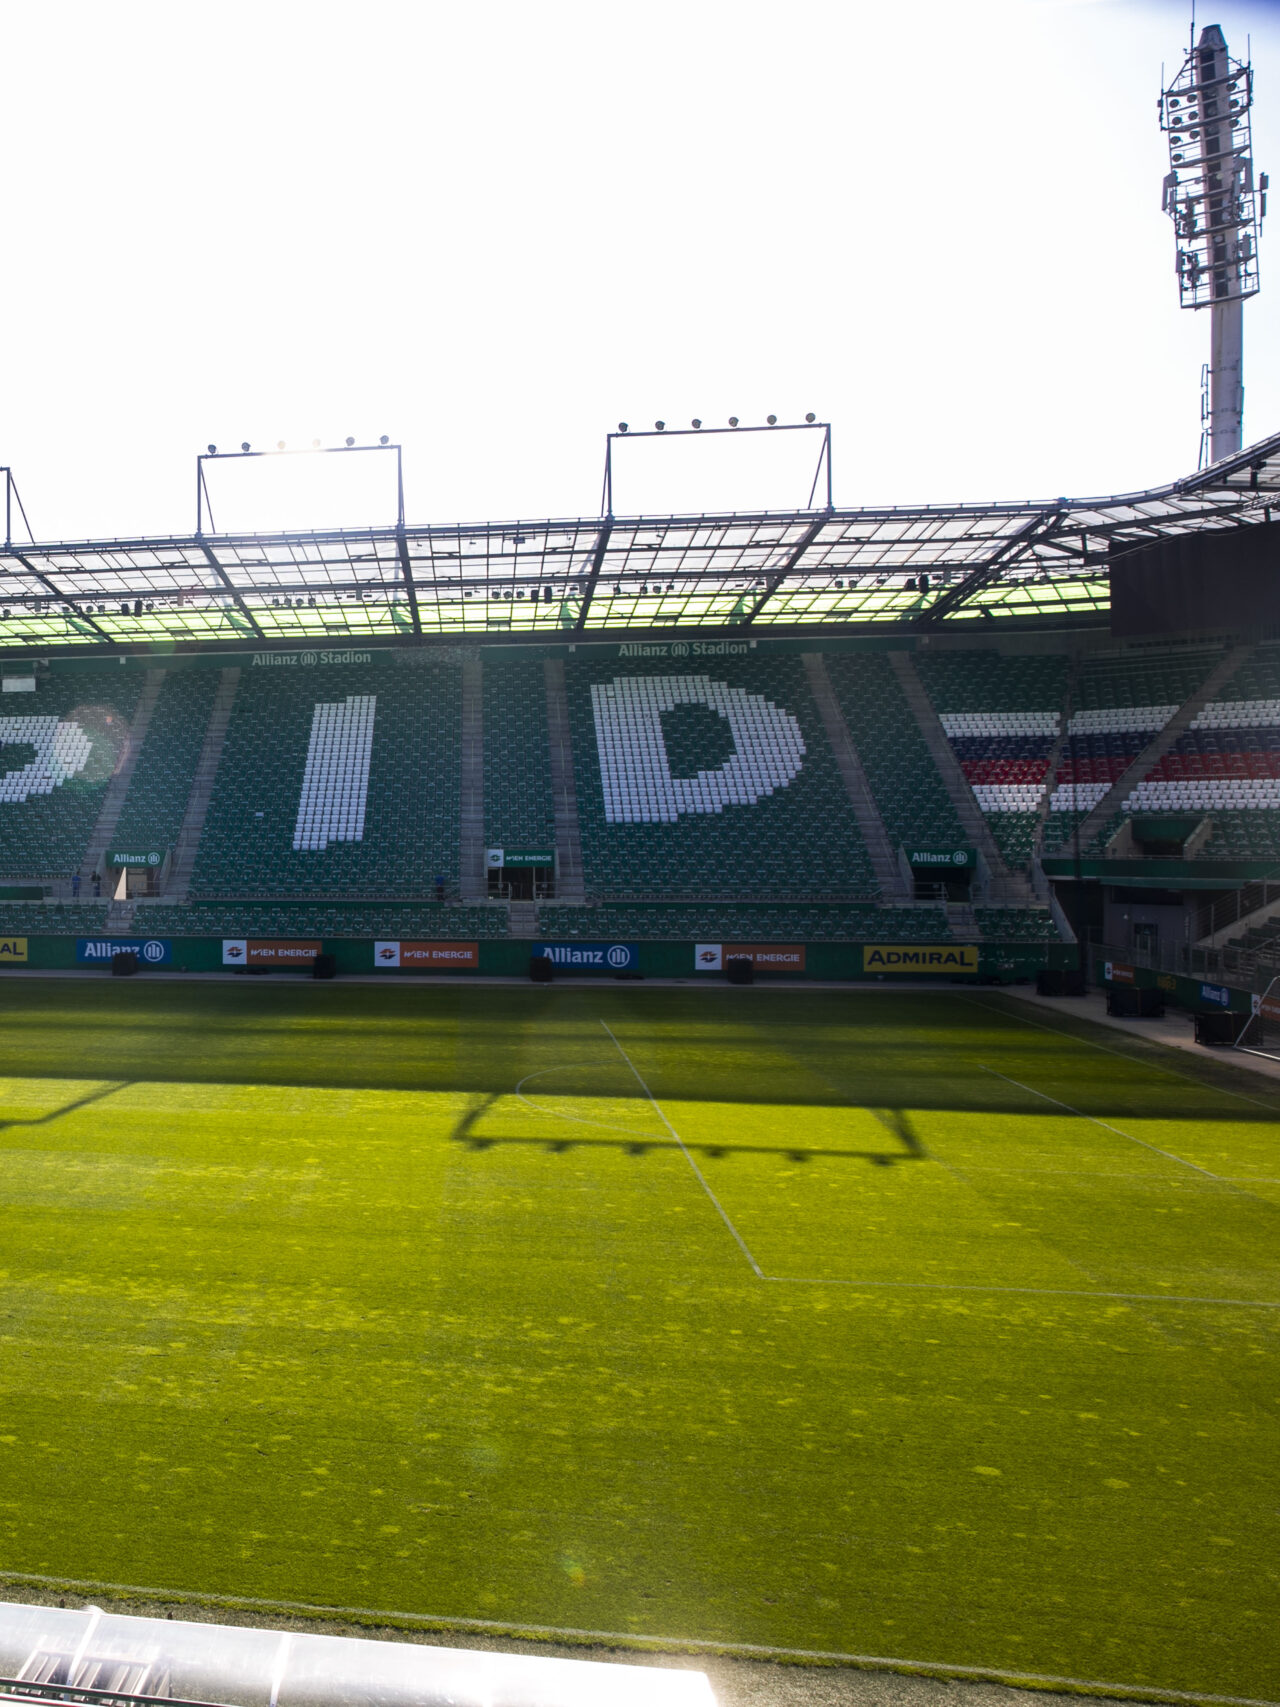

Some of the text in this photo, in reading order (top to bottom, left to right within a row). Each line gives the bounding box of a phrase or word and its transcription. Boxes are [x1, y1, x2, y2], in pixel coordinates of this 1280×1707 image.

[618, 641, 747, 656] Allianz Stadion
[252, 652, 371, 665] Allianz Stadion
[113, 854, 146, 863] Allianz
[912, 852, 951, 863] Allianz
[278, 948, 318, 958] ENERGIE
[432, 951, 473, 959] ENERGIE
[543, 947, 604, 963] Allianz
[756, 953, 800, 963] ENERGIE
[867, 950, 973, 966] ADMIRAL
